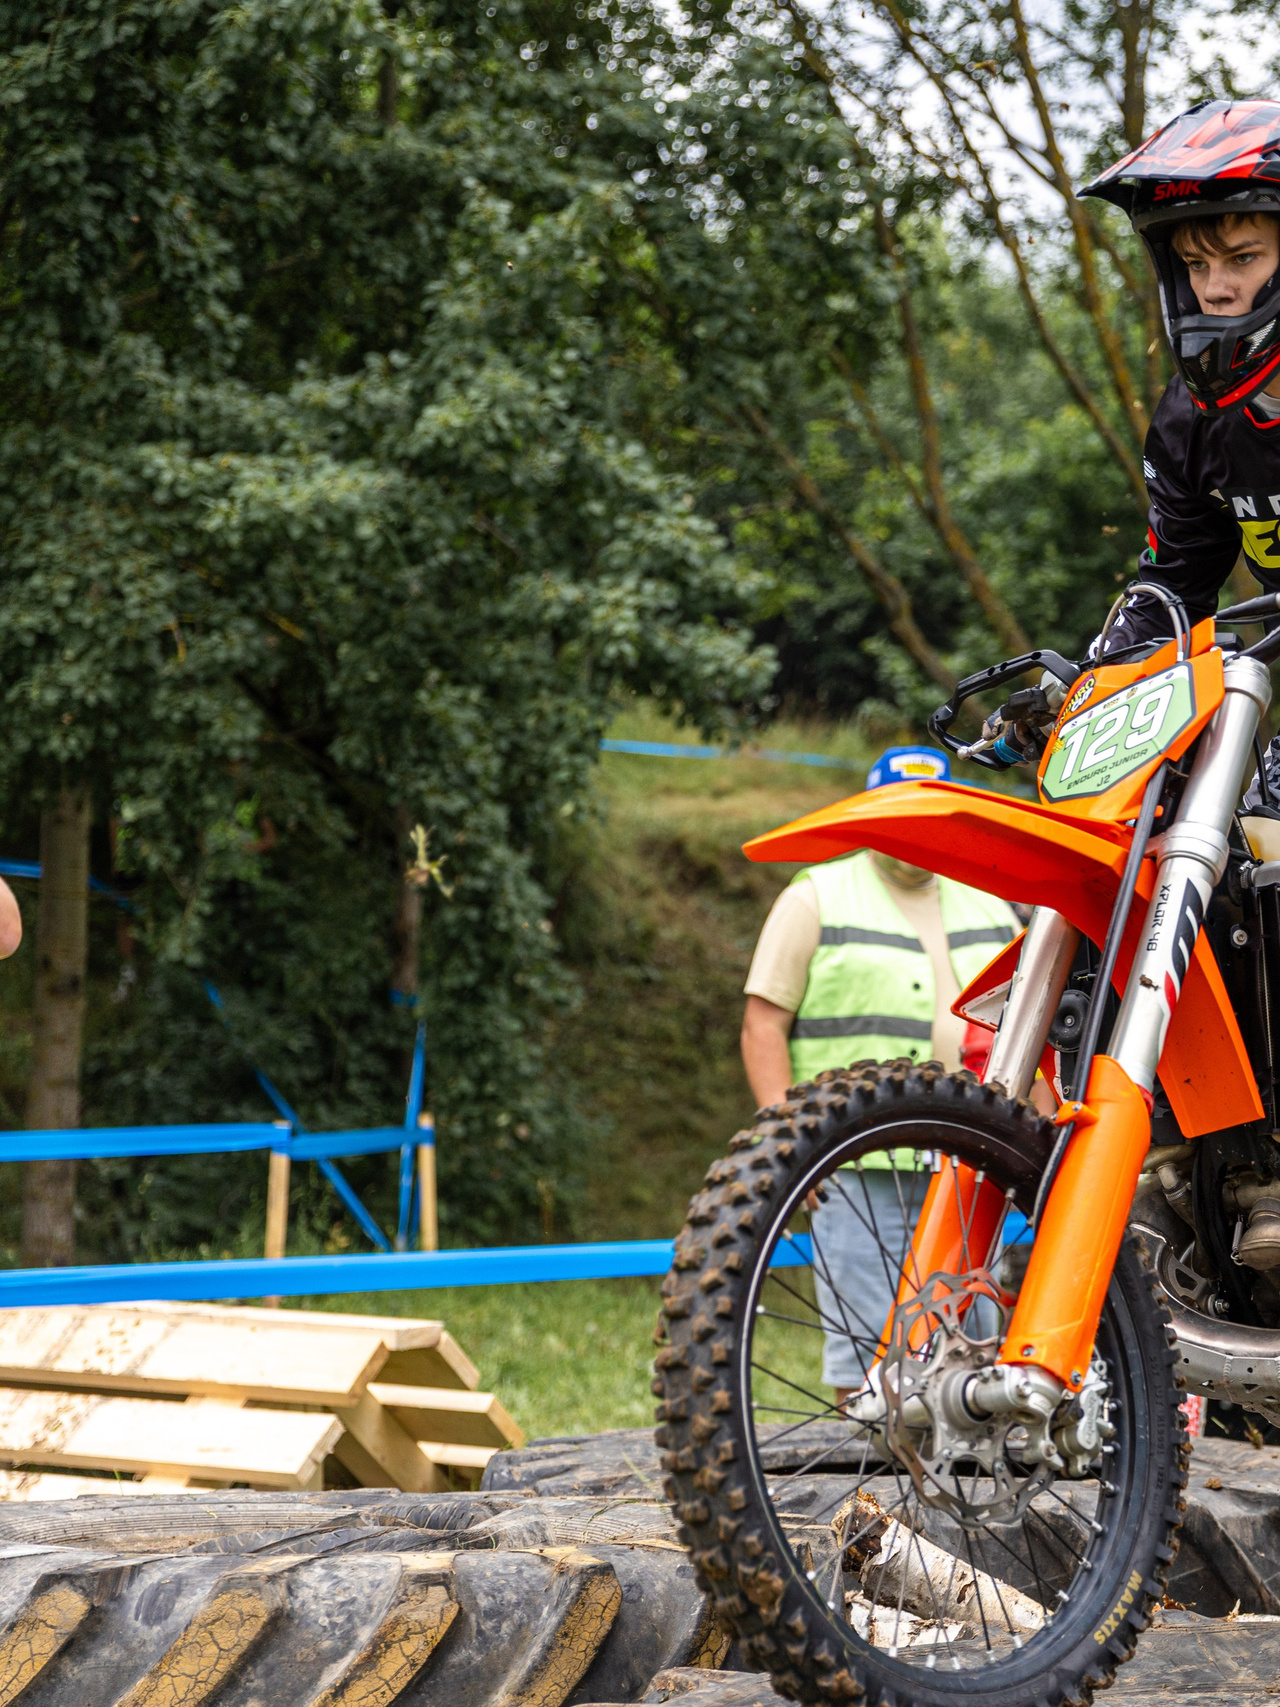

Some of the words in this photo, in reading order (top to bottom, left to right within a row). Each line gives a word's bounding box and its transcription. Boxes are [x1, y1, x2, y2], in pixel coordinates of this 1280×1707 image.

[1153, 180, 1202, 201] SMK
[1059, 684, 1175, 783] 129
[1066, 765, 1108, 790] ENDURO
[1109, 749, 1149, 770] JUNIOR
[1096, 774, 1111, 788] J2
[1152, 884, 1171, 929] XPLOR
[1147, 932, 1160, 952] 48
[1094, 1570, 1143, 1645] MAXXIS
